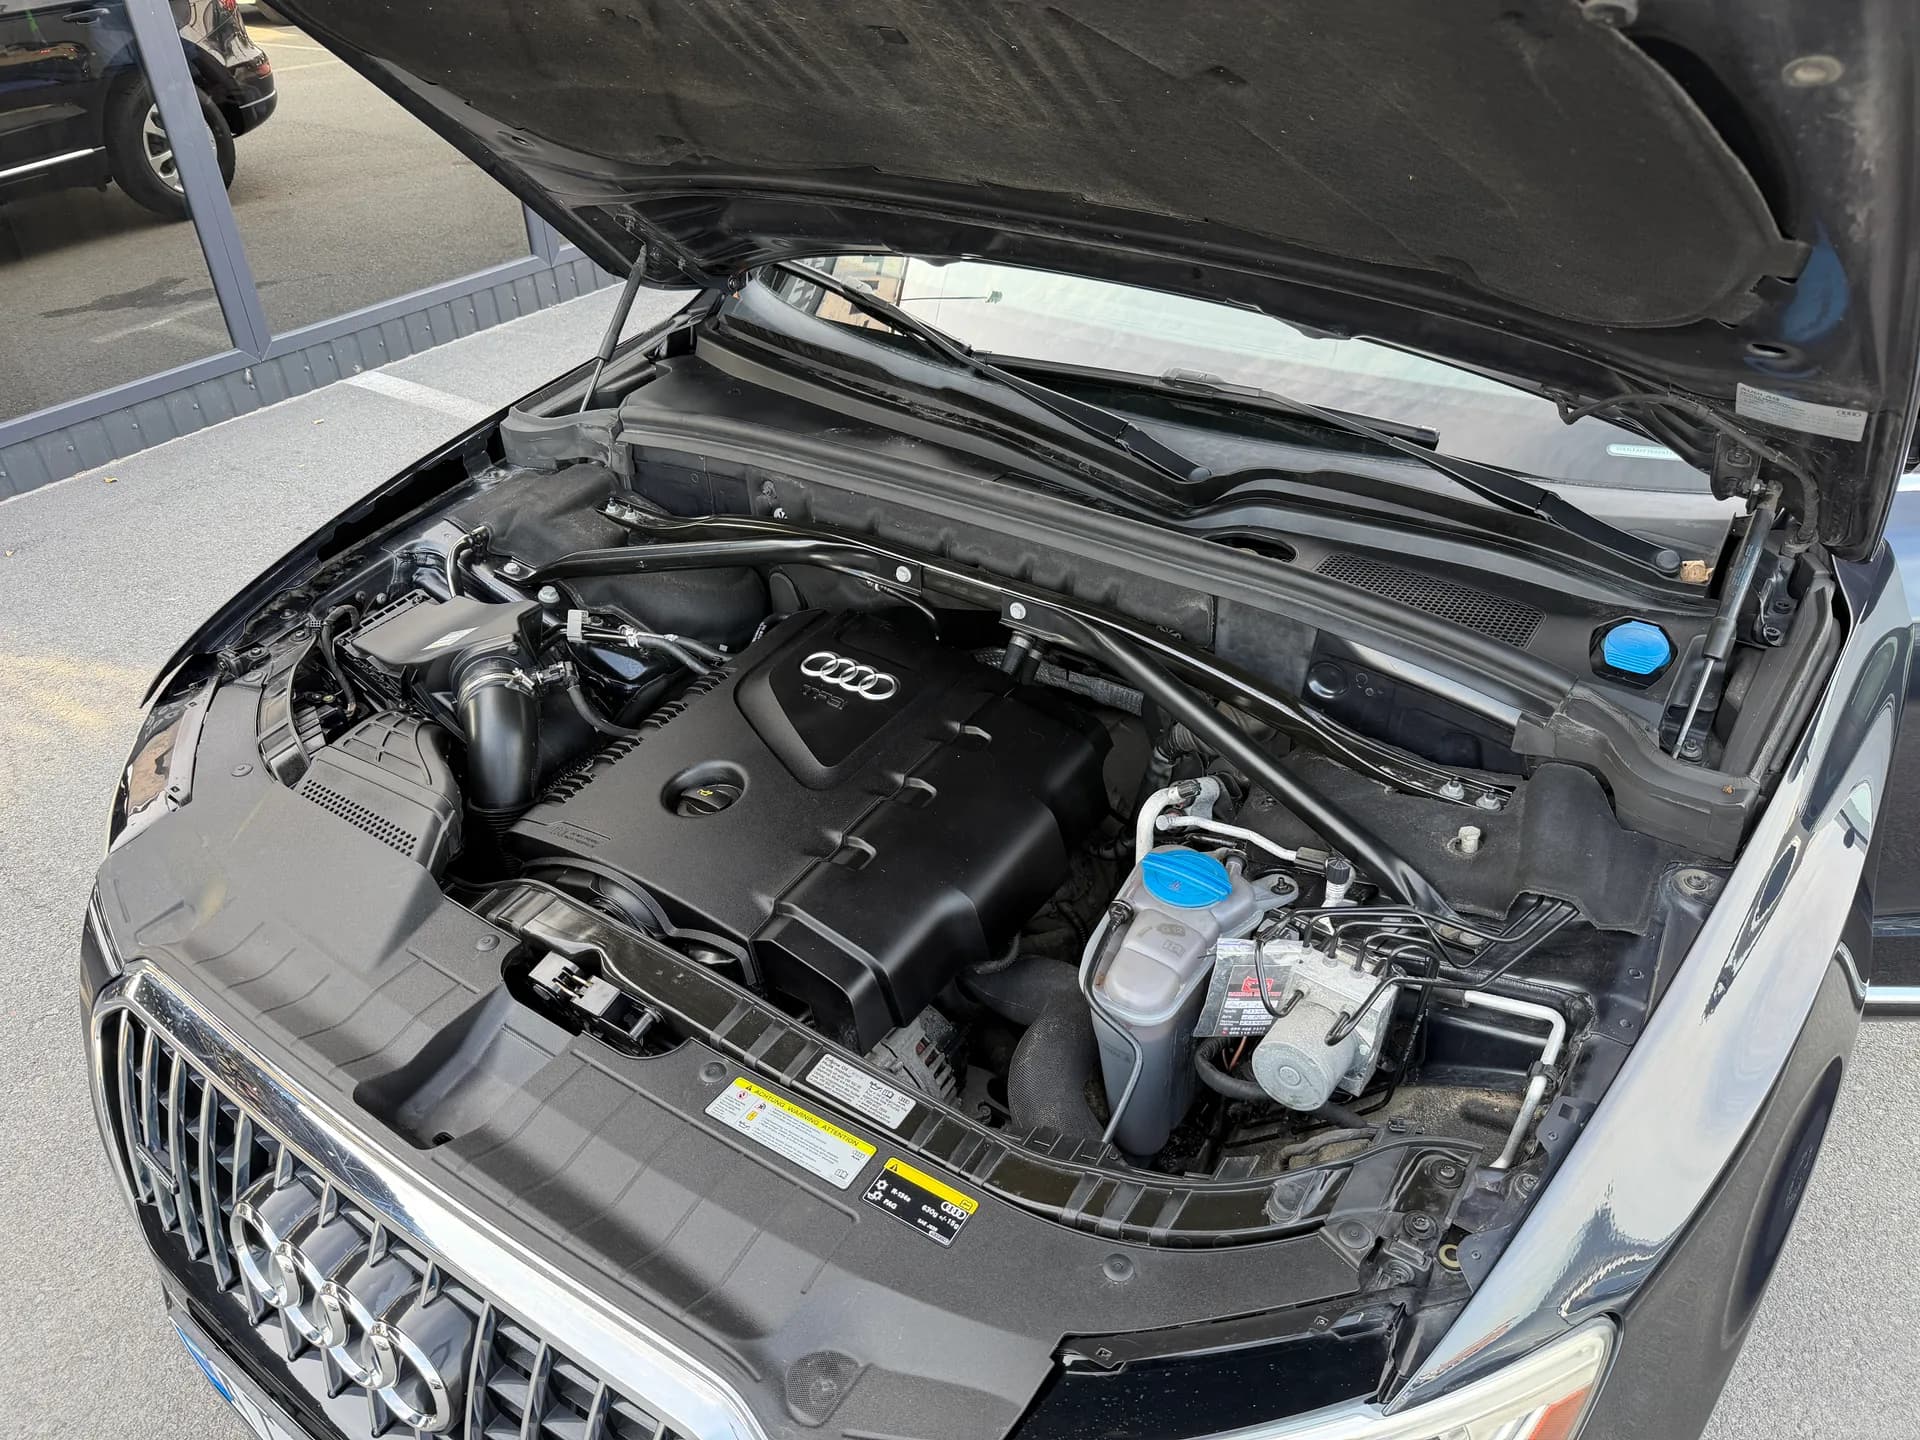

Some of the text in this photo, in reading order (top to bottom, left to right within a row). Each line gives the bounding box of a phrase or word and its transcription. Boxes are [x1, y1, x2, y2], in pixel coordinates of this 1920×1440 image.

[753, 1088, 786, 1109] ACHTUNG
[787, 1105, 820, 1127] WARNING
[821, 1123, 859, 1147] ATTENTION
